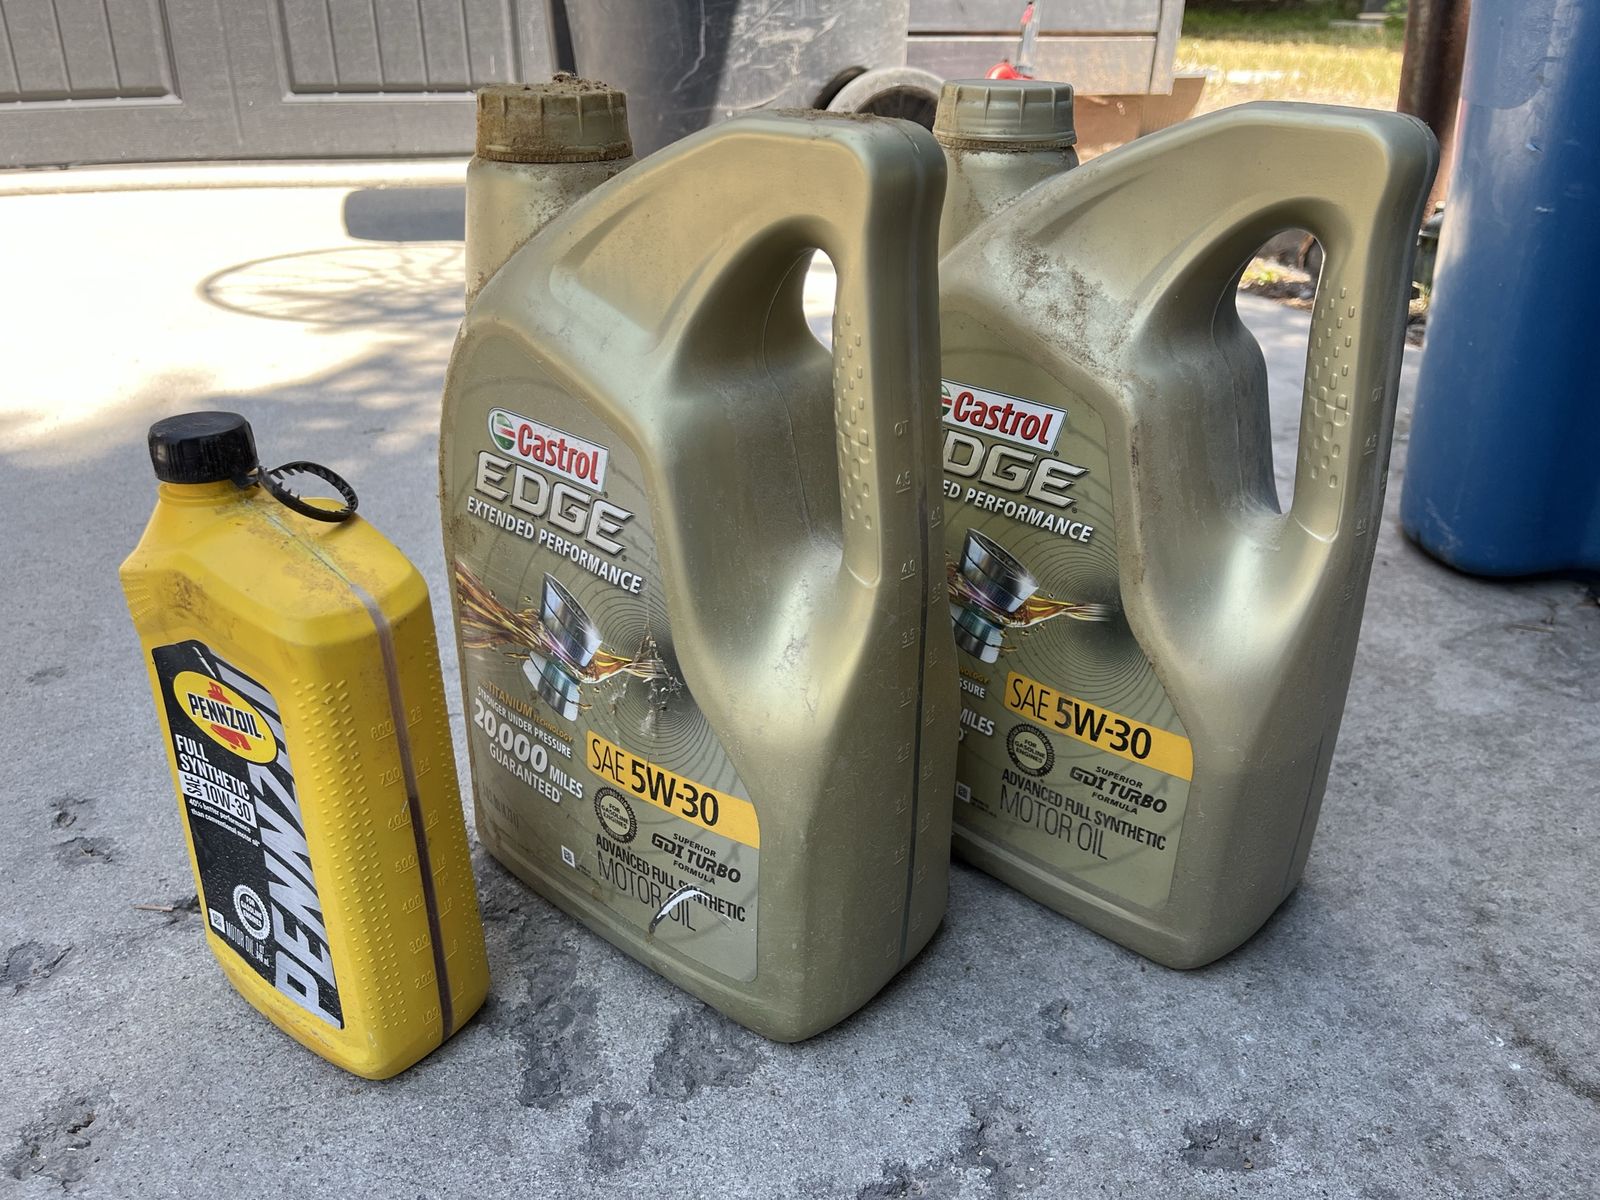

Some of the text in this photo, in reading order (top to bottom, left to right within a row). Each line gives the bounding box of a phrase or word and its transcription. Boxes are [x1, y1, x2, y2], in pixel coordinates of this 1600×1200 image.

[953, 391, 1054, 445] Castrol
[516, 422, 600, 485] Castrol
[943, 428, 1091, 508] DGE
[475, 450, 635, 556] EDGE
[964, 488, 1094, 543] PERFORMANCE
[467, 496, 643, 595] EXTENDED PERFORMANCE
[489, 681, 573, 743] TITANIUM TECHNOLOGY
[960, 678, 986, 699] SSURE
[186, 692, 263, 739] PENNZOIL
[478, 686, 572, 759] STRONGER UNDER PRESSURE
[960, 708, 995, 736] MILES
[1010, 678, 1050, 722] SAE
[1054, 696, 1152, 760] 5W-30
[175, 734, 209, 762] FULL
[474, 698, 583, 799] 20,000 MILES
[1014, 740, 1046, 759] GASOLINE
[1015, 747, 1043, 764] ENGINES
[1023, 739, 1037, 749] FOR
[179, 753, 250, 800] SYNTHETIC
[184, 774, 252, 823] SAE 10W-30
[592, 738, 625, 785] SAE
[631, 759, 719, 827] 5W-30
[1069, 766, 1167, 814] GDI TURBO
[1095, 766, 1143, 789] SUPERIOR
[190, 808, 205, 819] than
[601, 804, 629, 824] GASOLINE
[602, 814, 628, 830] ENGINES
[608, 803, 621, 814] FOR
[1000, 785, 1073, 844] MOTOR
[1077, 822, 1108, 861] OIL
[1001, 768, 1063, 808] ADVANCED
[1065, 796, 1092, 822] FULL
[1094, 810, 1167, 851] SYNTHETIC
[1091, 792, 1138, 815] FORMULA
[207, 645, 343, 1029] PENNZI
[651, 832, 741, 883] GDI TURBO
[672, 833, 716, 858] SUPERIOR
[595, 833, 650, 876] ADVANCED
[652, 865, 677, 892] FULL
[678, 879, 746, 922] STHETIC
[597, 851, 662, 909] MOTOR
[673, 859, 716, 885] FORMULA
